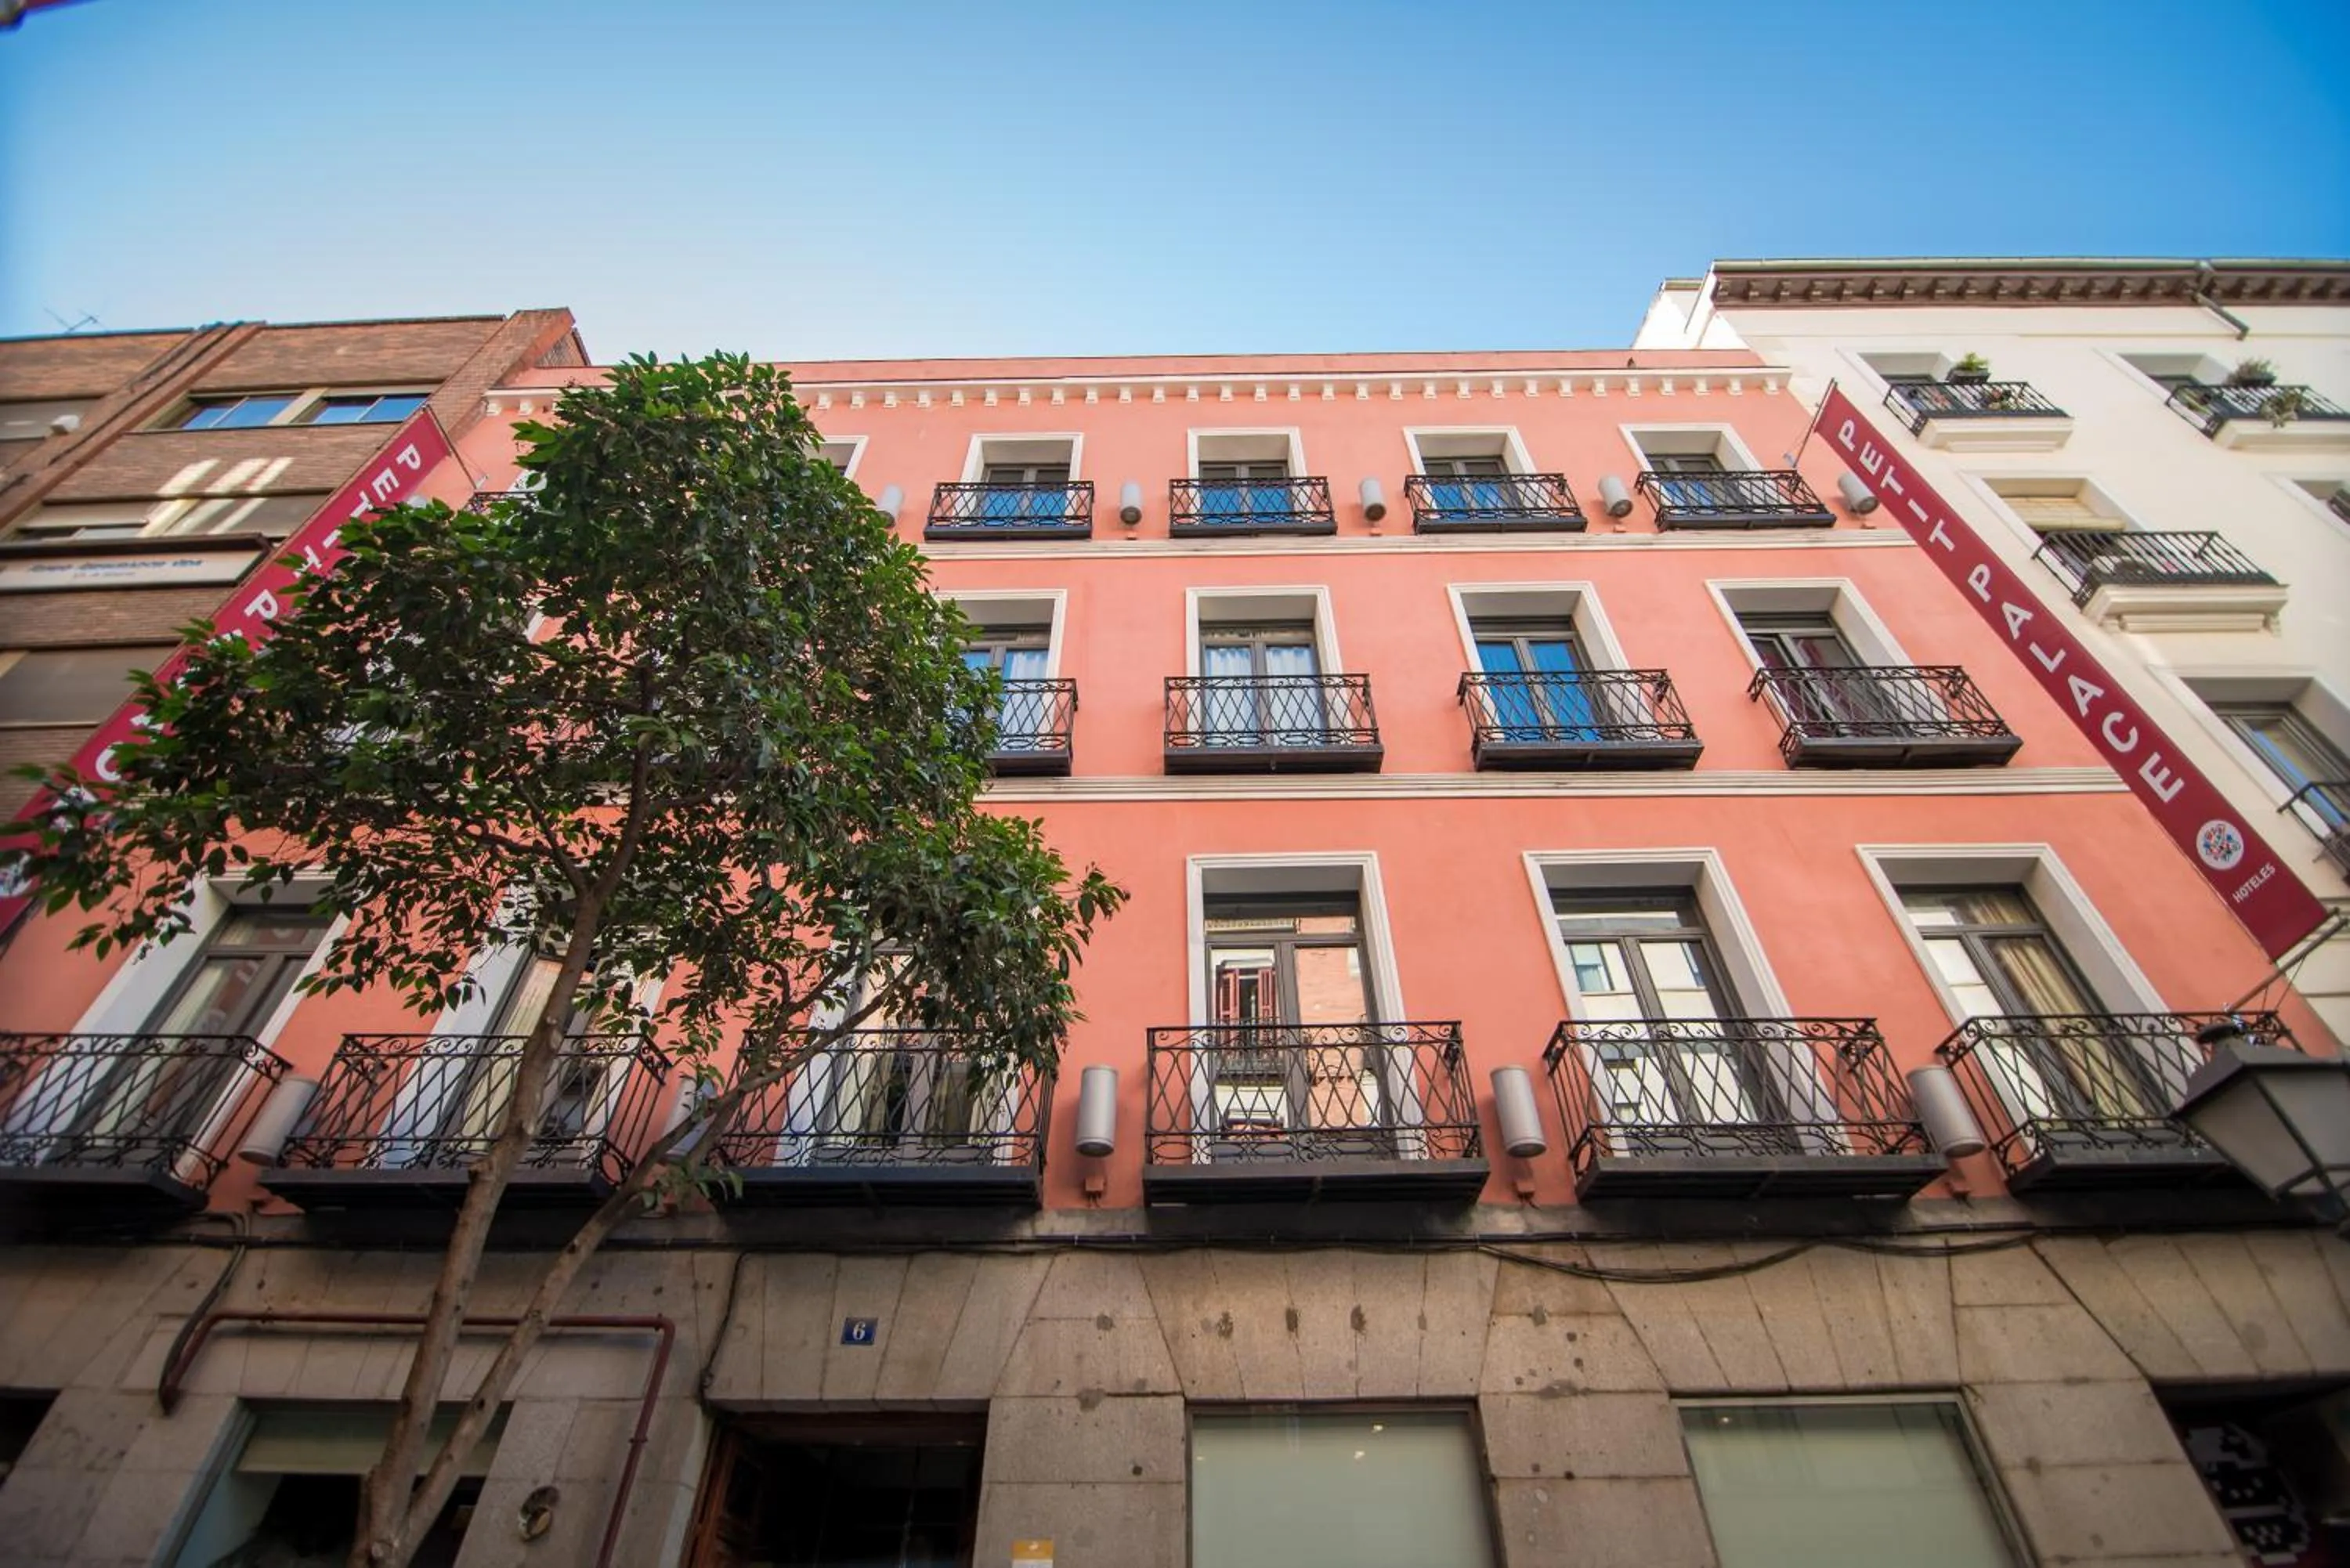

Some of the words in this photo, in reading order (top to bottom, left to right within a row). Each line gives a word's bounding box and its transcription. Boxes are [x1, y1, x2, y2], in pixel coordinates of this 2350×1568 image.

[292, 443, 421, 578] PETIT
[1838, 419, 1955, 551] PETIT
[1967, 564, 2185, 803] PALACE
[2232, 862, 2276, 903] HOTELES
[852, 1321, 866, 1341] 6
